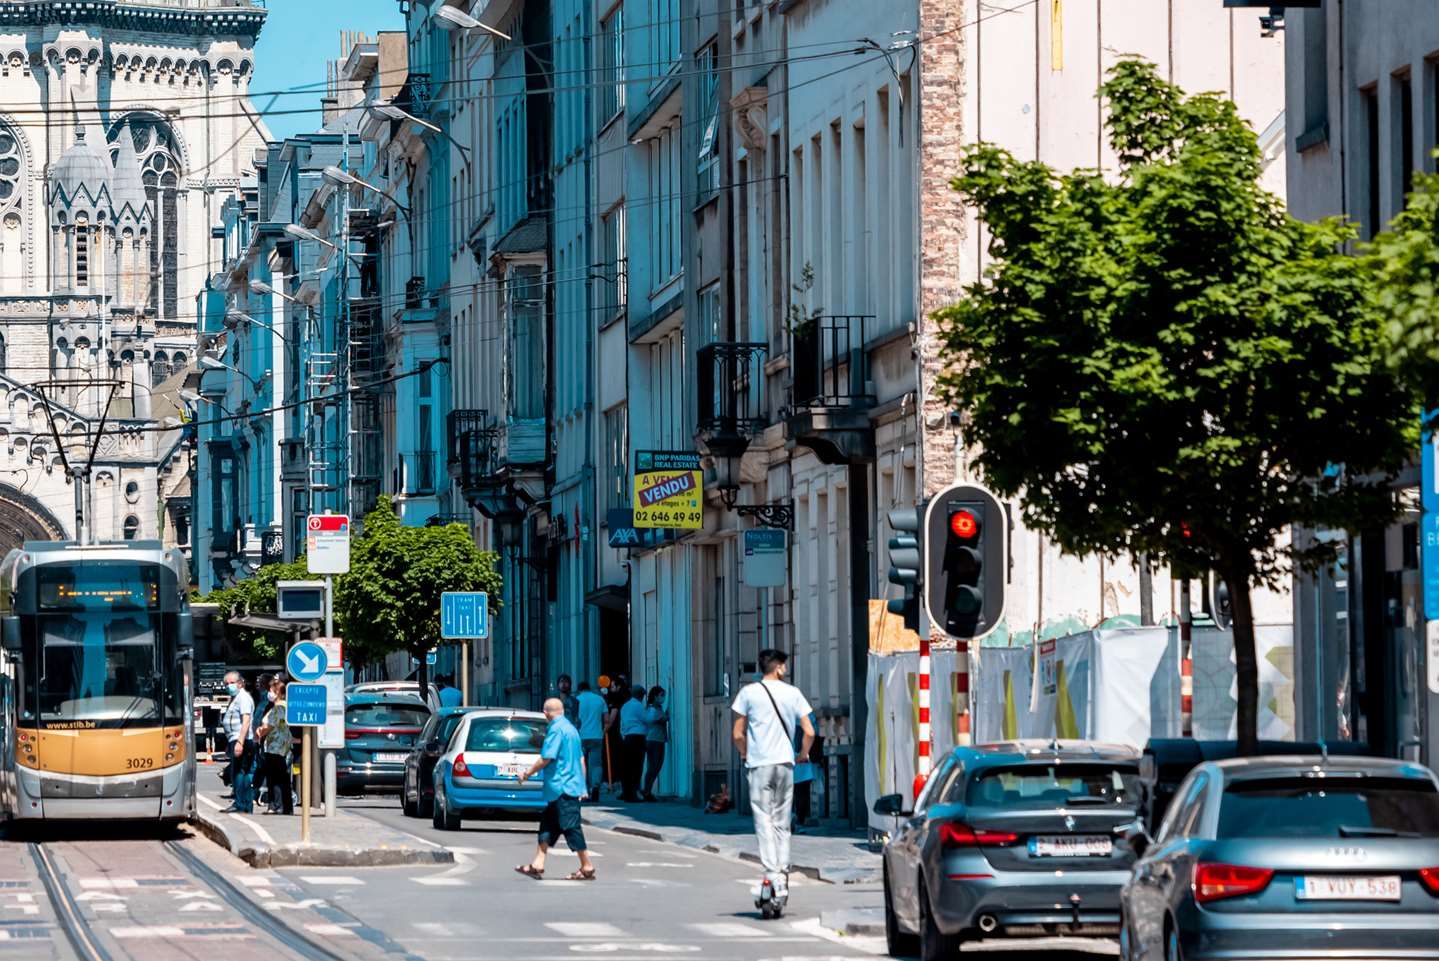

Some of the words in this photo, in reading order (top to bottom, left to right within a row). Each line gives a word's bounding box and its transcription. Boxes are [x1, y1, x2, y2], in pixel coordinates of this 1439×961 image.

[644, 476, 689, 502] VENDU
[635, 511, 648, 521] 02
[651, 511, 670, 522] 646
[673, 512, 686, 522] 49
[688, 512, 701, 522] 49
[609, 528, 639, 543] AXA
[297, 712, 318, 722] TAXI
[47, 721, 96, 729] www.stib.be
[126, 758, 154, 769] 3029
